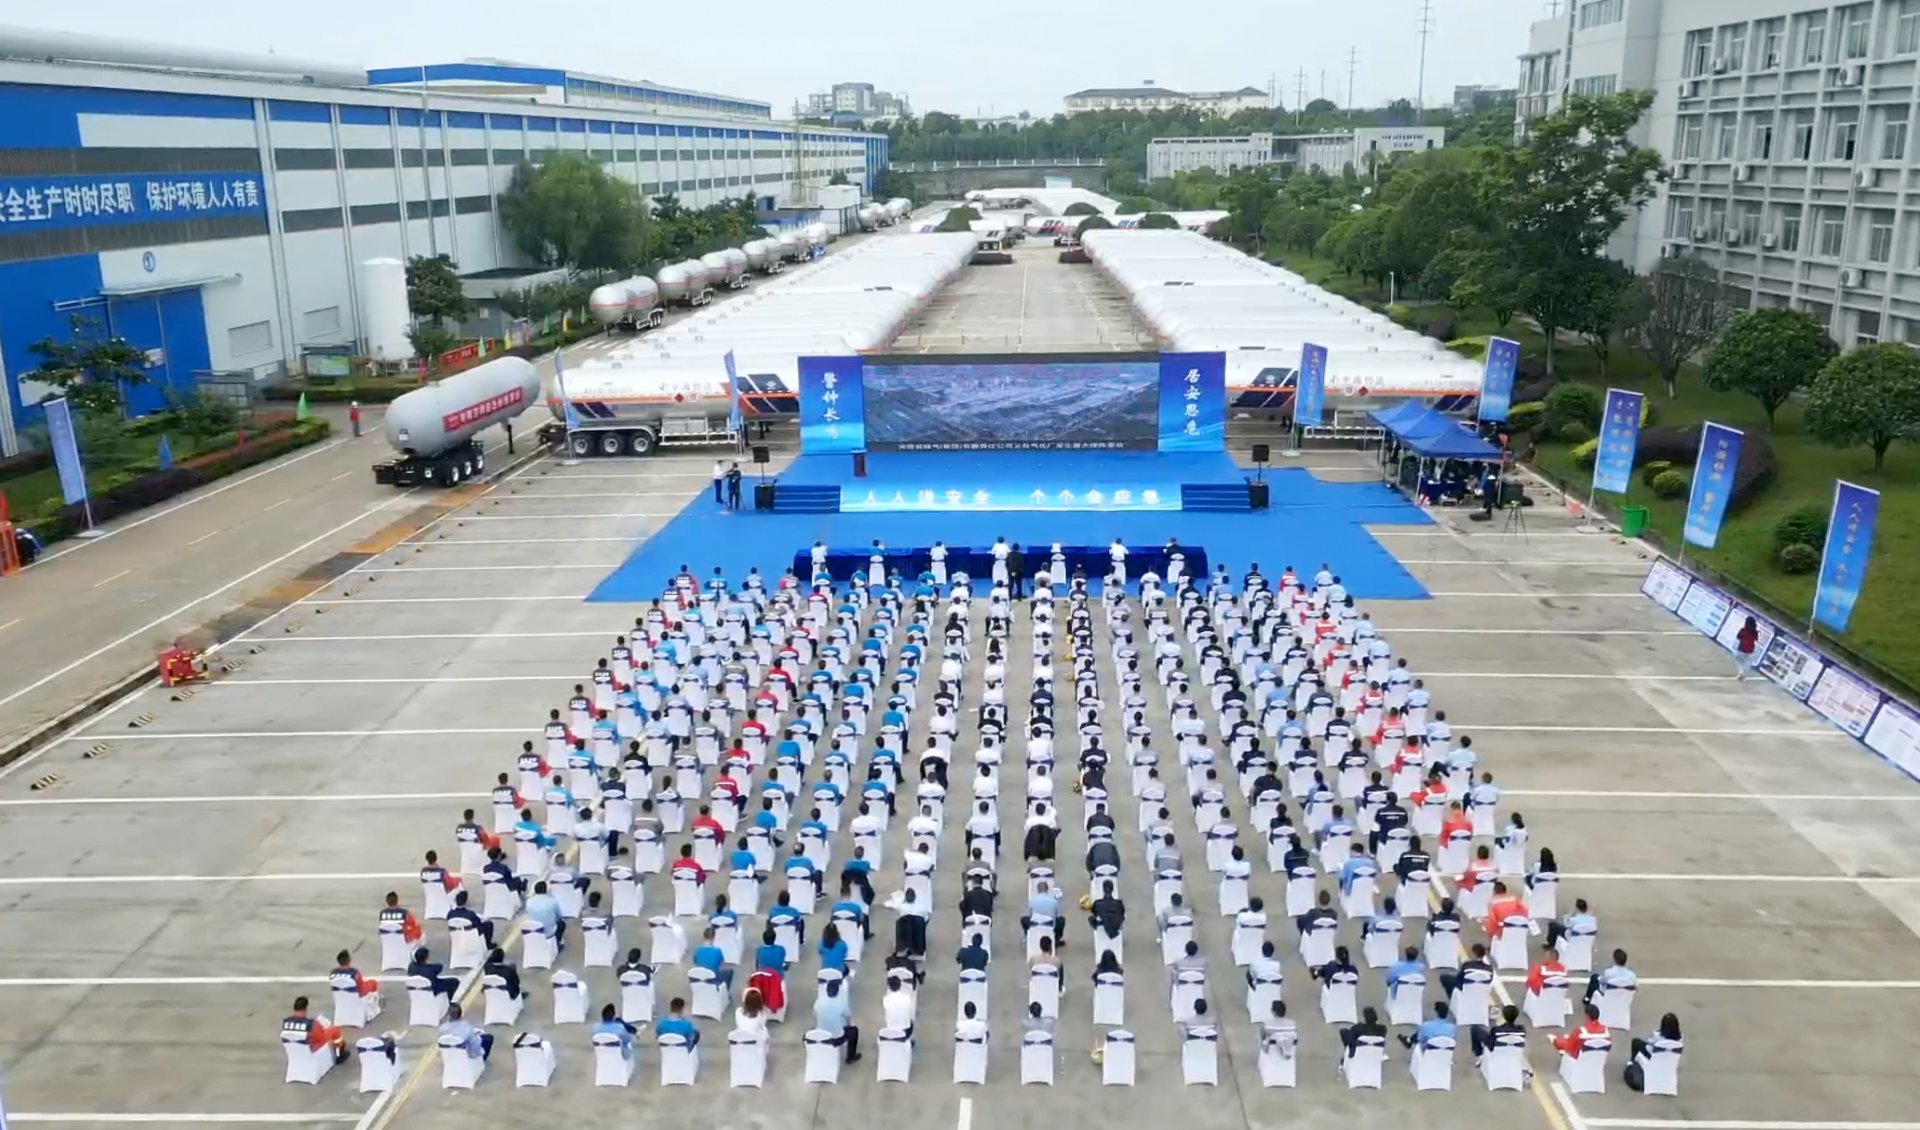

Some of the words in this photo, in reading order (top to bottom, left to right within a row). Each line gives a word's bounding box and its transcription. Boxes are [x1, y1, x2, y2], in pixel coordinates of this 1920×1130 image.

[0, 182, 135, 222] 全生产时时尽职
[146, 180, 259, 211] 保护环境人人有责
[1184, 368, 1201, 436] 居安思危
